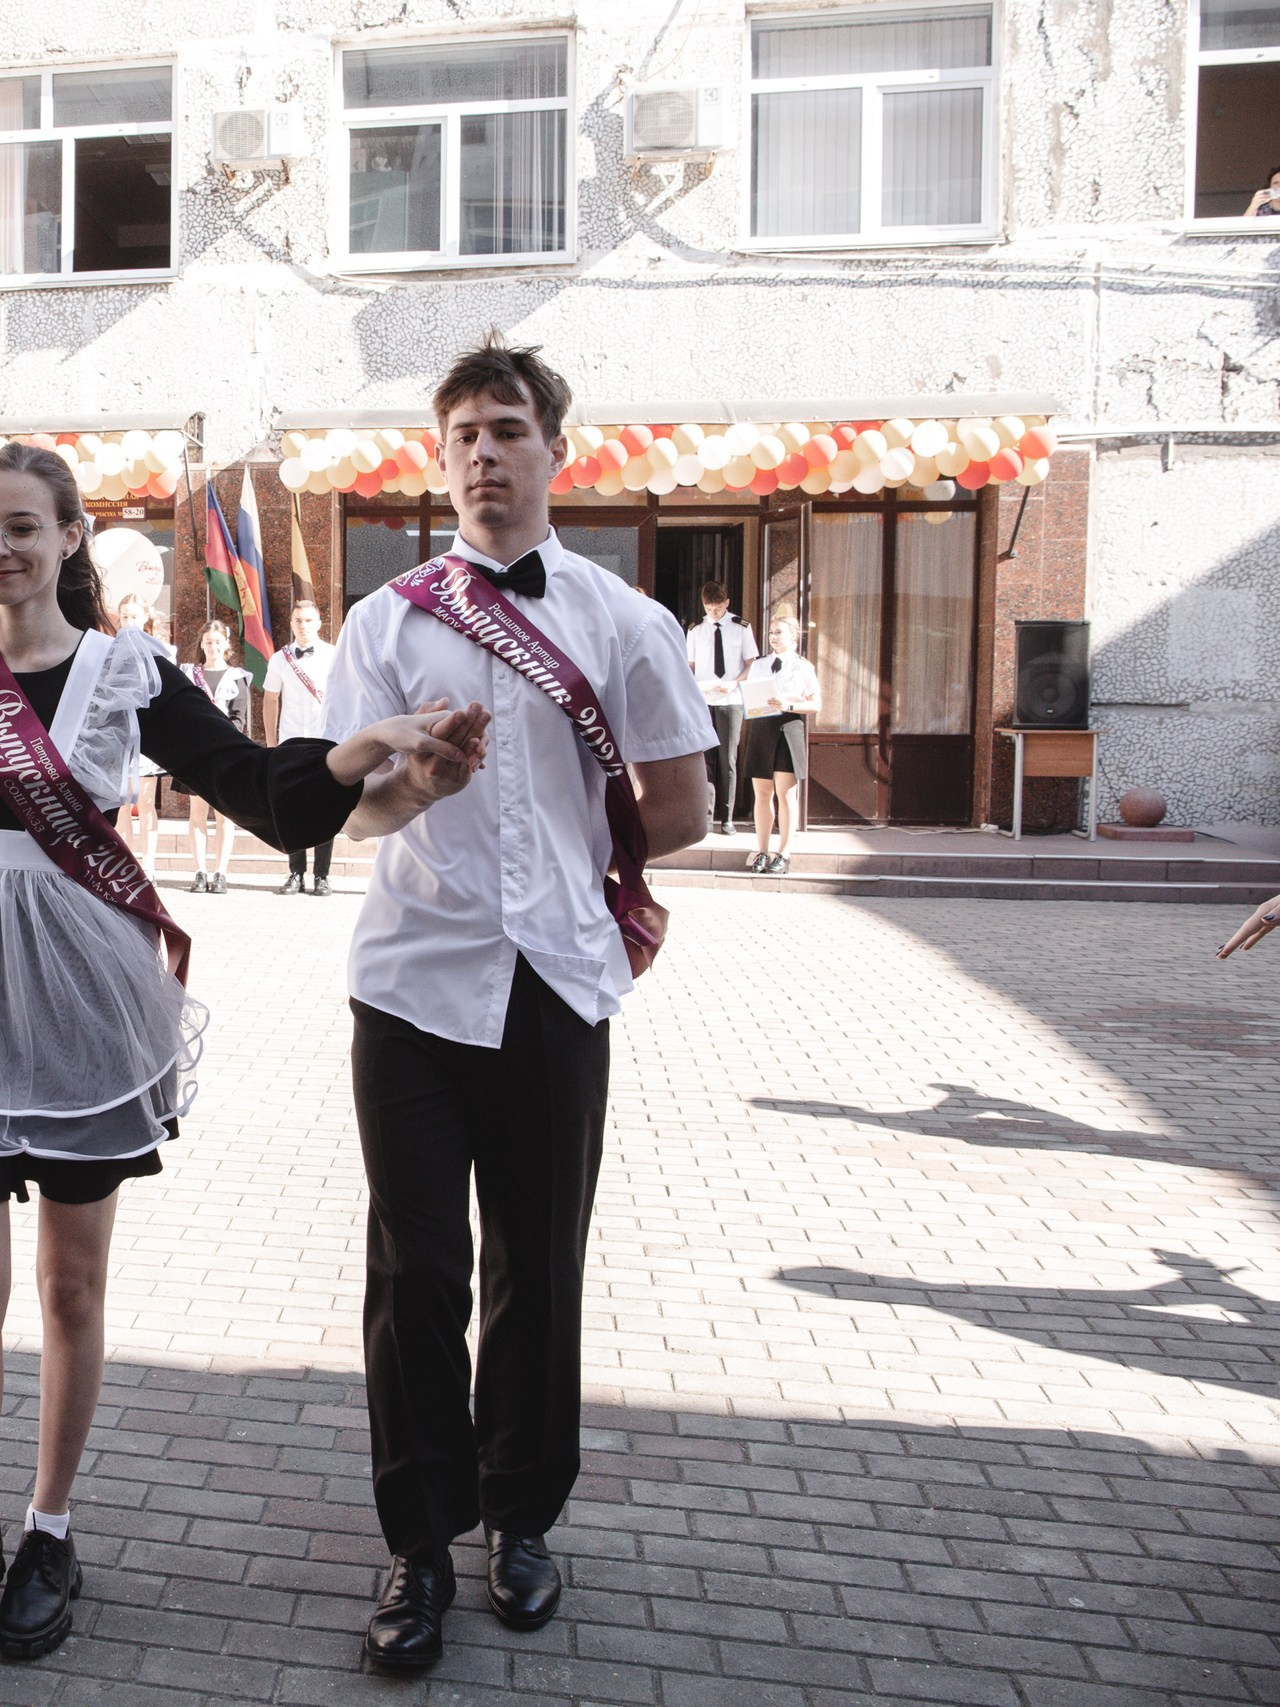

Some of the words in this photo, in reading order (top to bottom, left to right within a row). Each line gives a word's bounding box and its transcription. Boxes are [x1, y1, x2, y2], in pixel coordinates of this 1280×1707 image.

[123, 508, 144, 516] 58-20
[429, 567, 572, 707] Выпускник
[488, 603, 531, 641] Рашитов
[527, 640, 560, 670] Артур
[3, 779, 27, 806] СОШ
[23, 805, 46, 833] №33
[29, 737, 60, 781] Петрова
[56, 781, 83, 812] Алина
[83, 841, 151, 905] 2024
